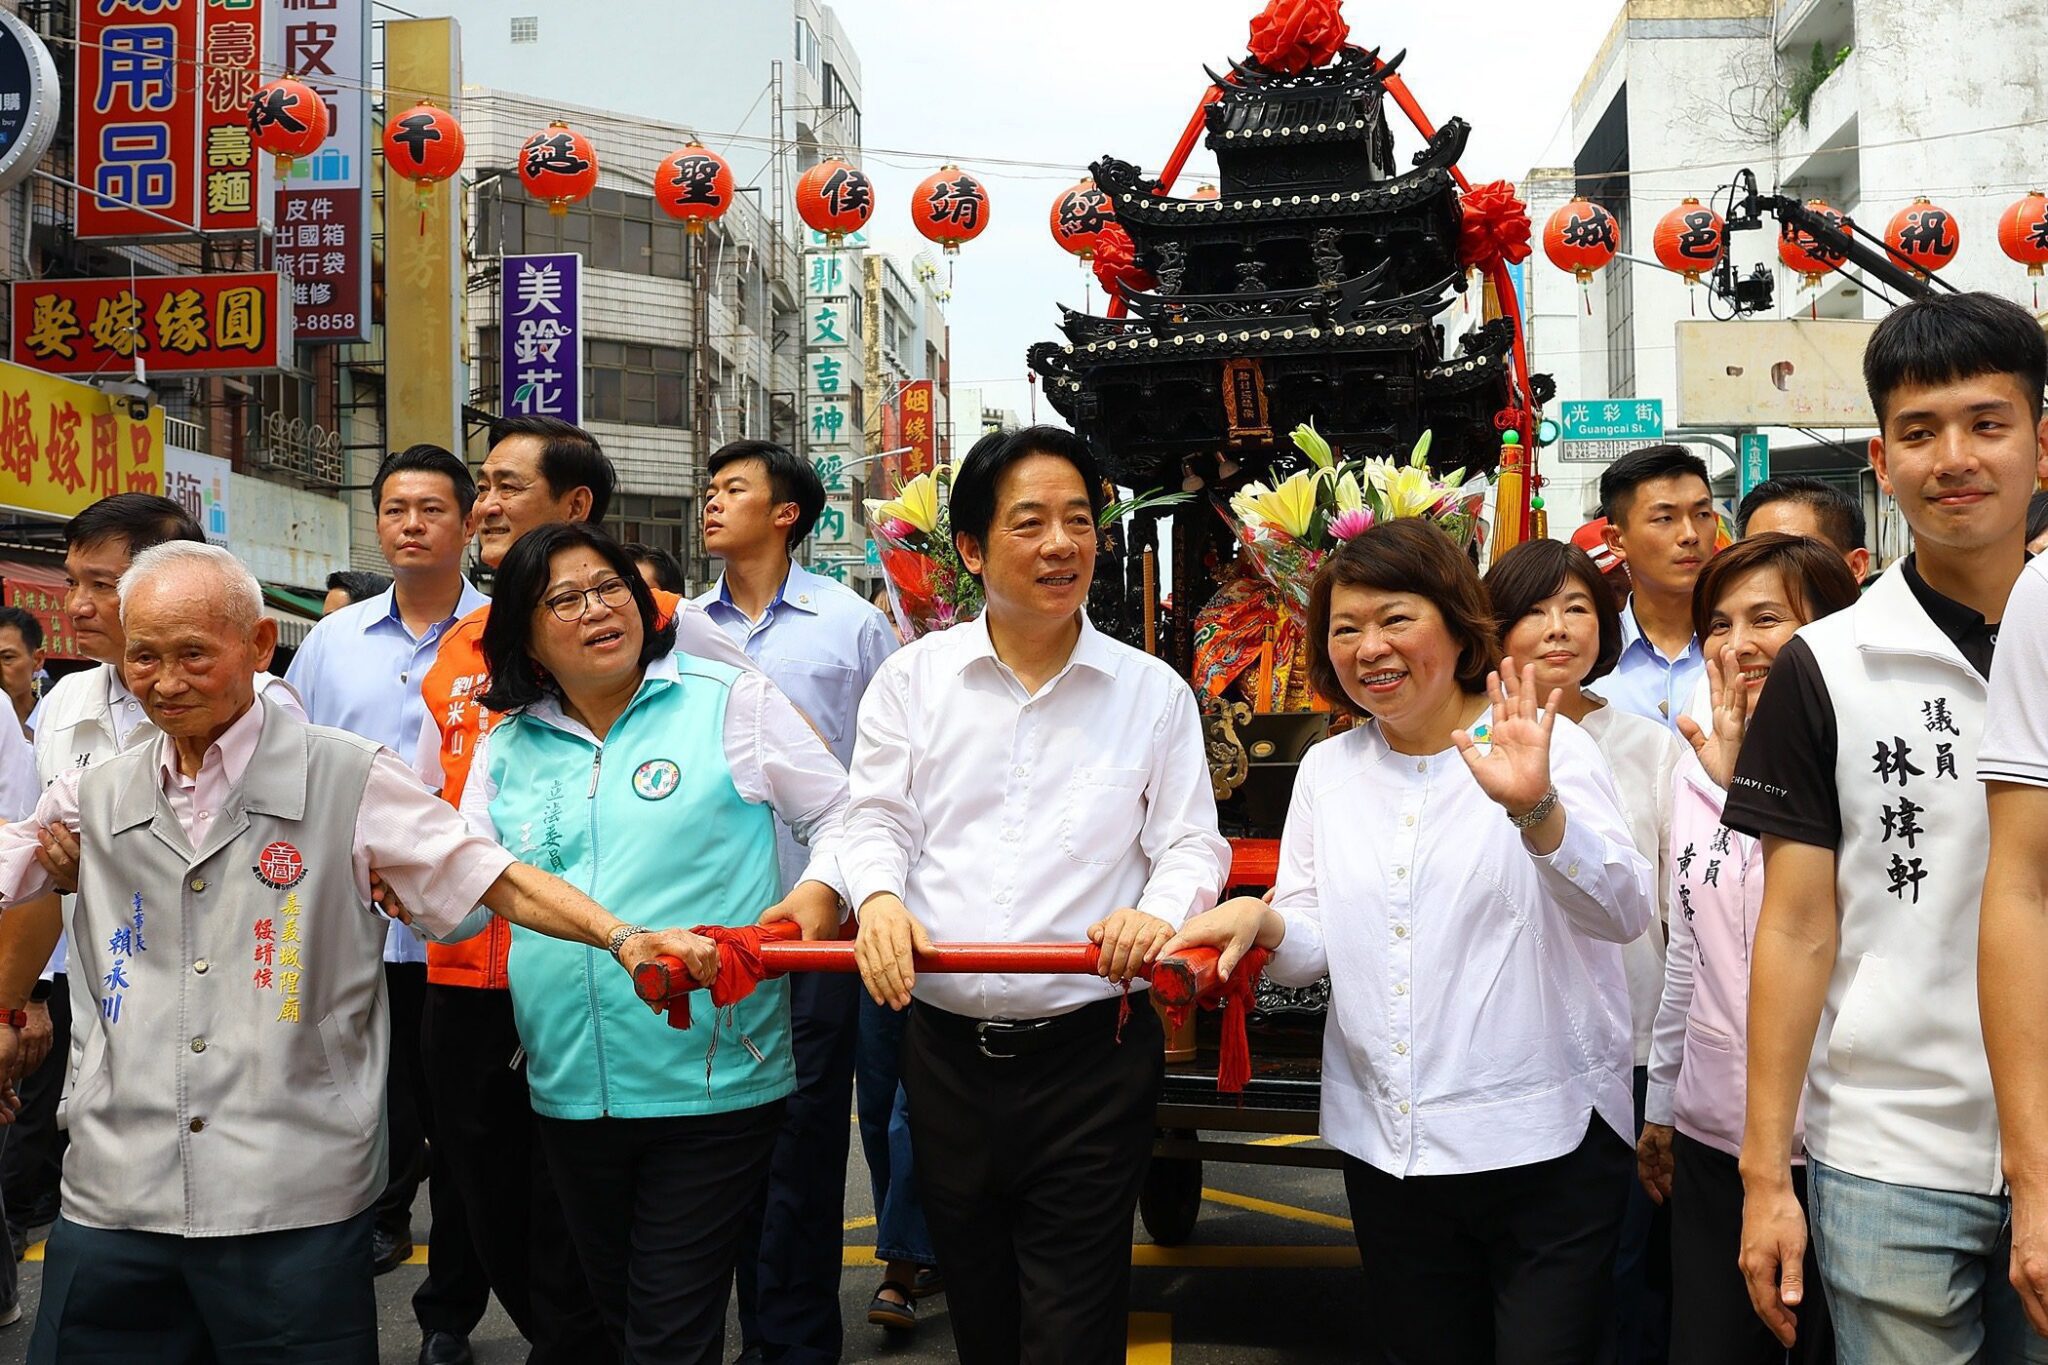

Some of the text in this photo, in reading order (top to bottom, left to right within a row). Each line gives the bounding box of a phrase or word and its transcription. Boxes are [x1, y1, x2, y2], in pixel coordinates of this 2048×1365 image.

[94, 0, 178, 211] 用品
[393, 114, 441, 164] 千
[672, 155, 721, 207] 聖
[823, 169, 871, 218] 侯
[929, 177, 984, 229] 靖
[286, 198, 333, 221] 皮件
[1562, 205, 1617, 253] 城
[1679, 212, 1720, 258] 邑
[1900, 211, 1955, 256] 祝
[275, 224, 345, 248] 出國箱
[276, 252, 345, 276] 旅行袋
[510, 261, 572, 414] 美鈴花
[1571, 403, 1653, 422] 光彩街
[1579, 424, 1646, 434] Guangcai St.
[1921, 697, 1960, 780] 議員
[1764, 784, 1788, 798] CITY
[1873, 736, 1928, 904] 林煒軒
[1701, 828, 1731, 888] 議員
[132, 891, 148, 952] 董事長
[101, 927, 133, 1025] 賴永川
[253, 917, 276, 990] 綏靖侯
[277, 891, 304, 1024] 嘉義城隍廟
